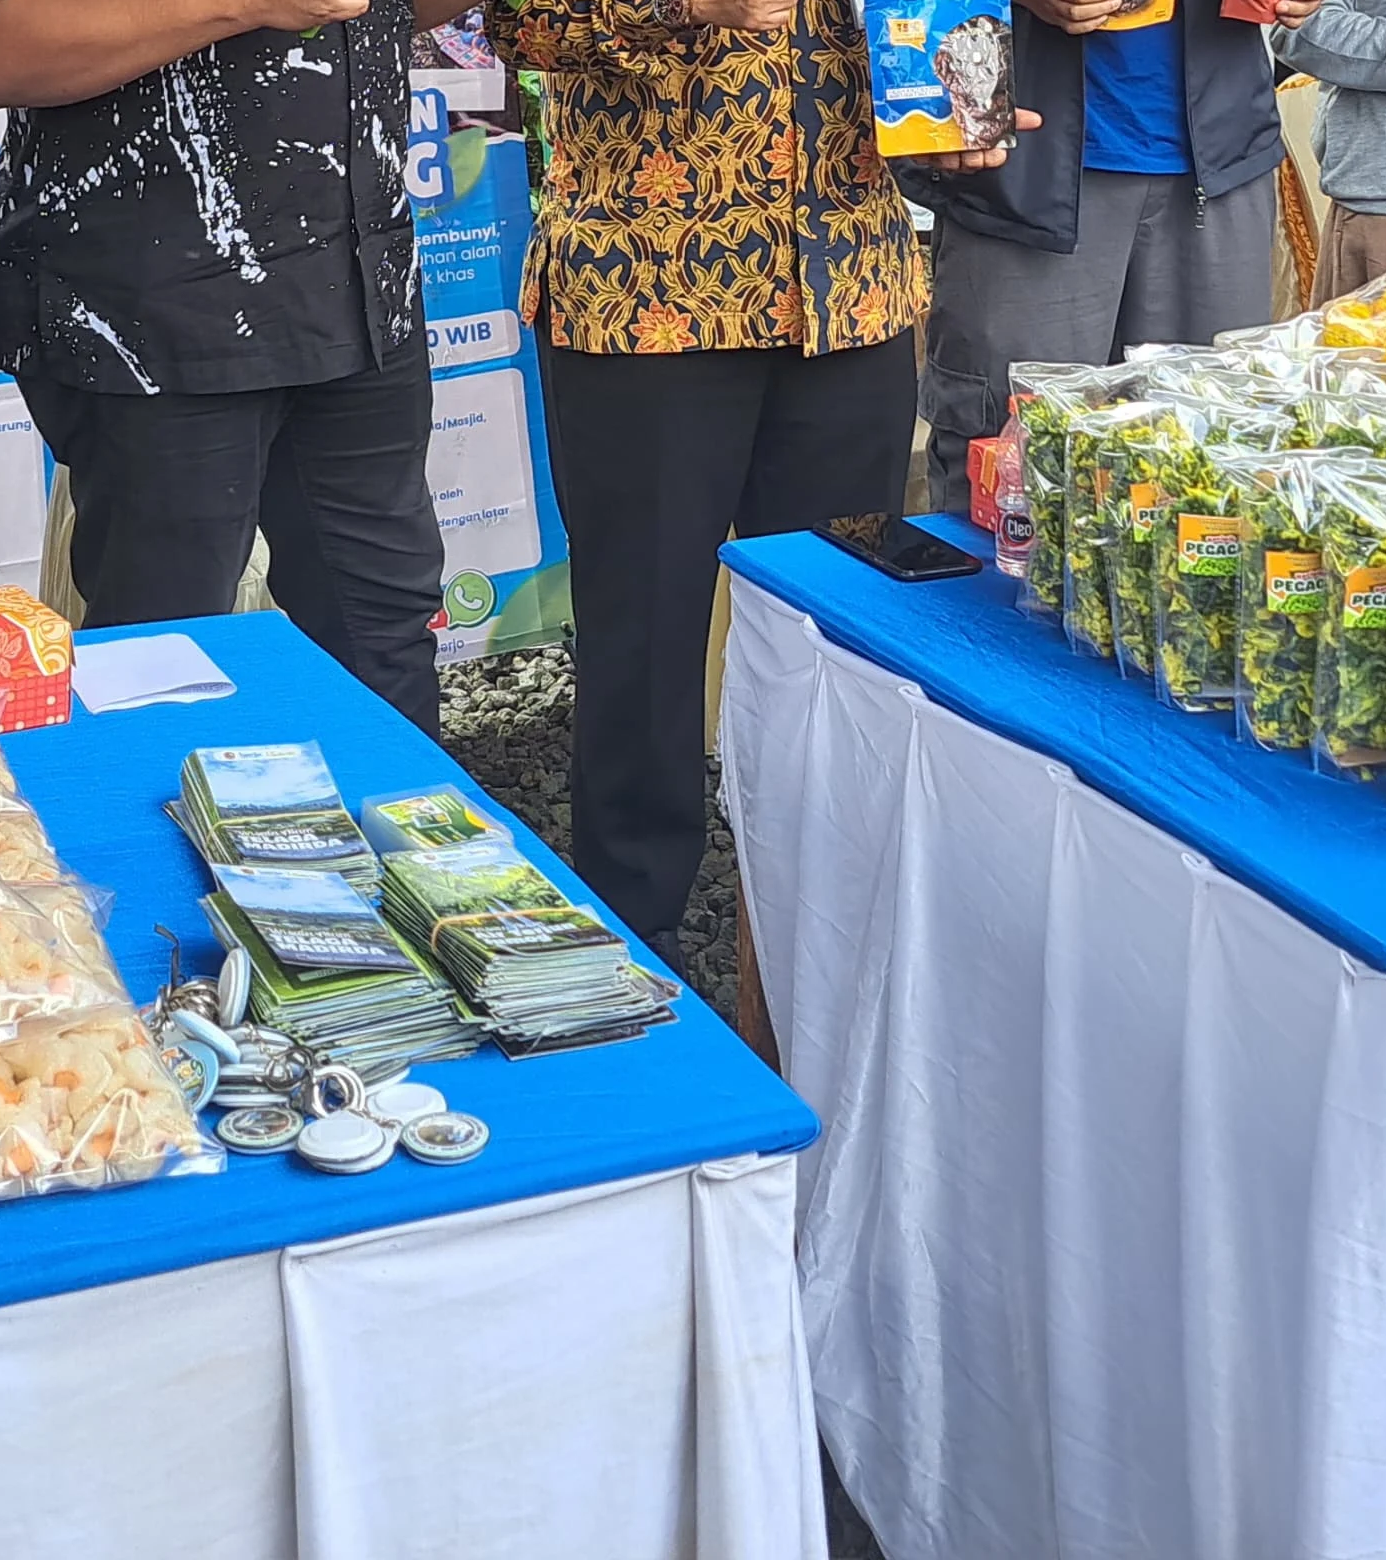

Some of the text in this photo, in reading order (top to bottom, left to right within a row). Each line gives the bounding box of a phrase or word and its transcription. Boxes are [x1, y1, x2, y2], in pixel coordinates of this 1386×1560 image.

[414, 220, 507, 247] sembunyi,"
[460, 244, 501, 262] alam
[437, 267, 475, 284] khas
[446, 321, 492, 346] WIB
[432, 414, 486, 433] a/Masjid,
[439, 488, 463, 501] oleh
[438, 507, 509, 528] dengan latar
[1007, 519, 1032, 537] Cleo
